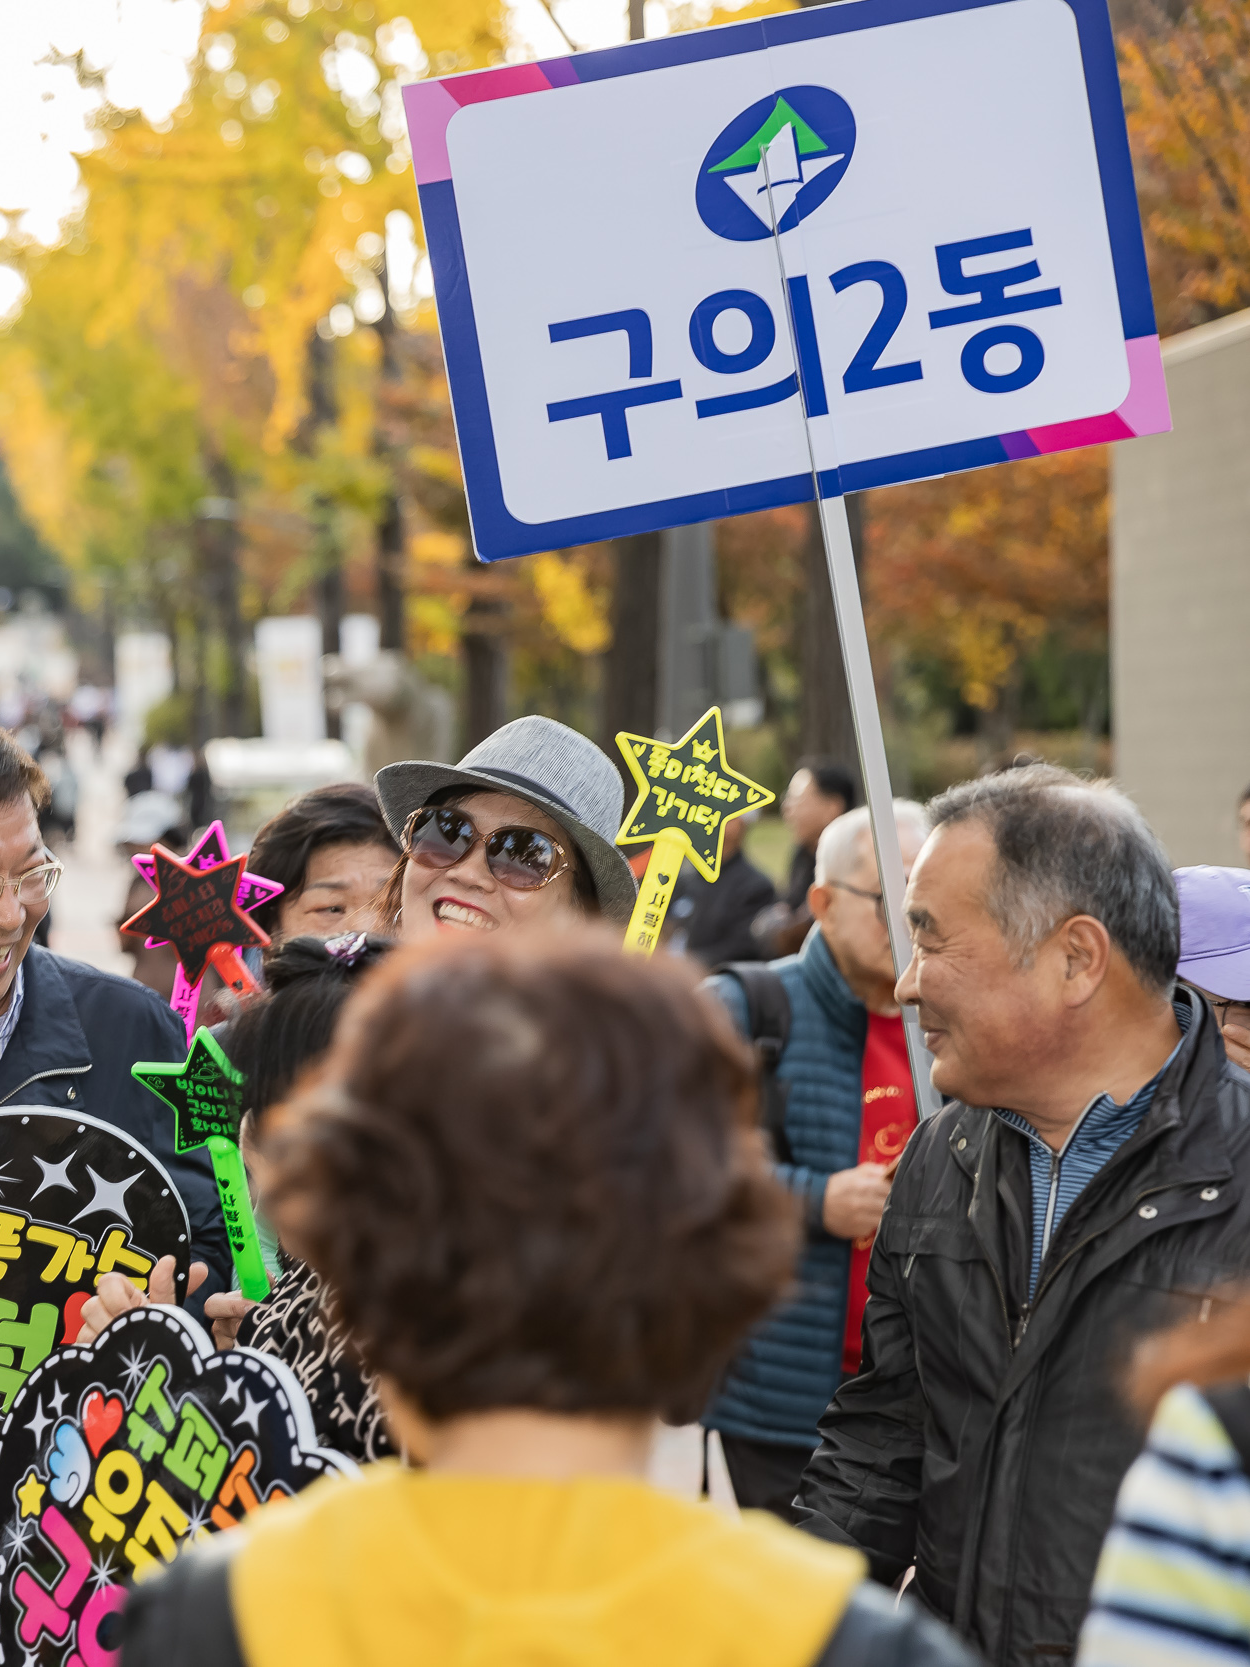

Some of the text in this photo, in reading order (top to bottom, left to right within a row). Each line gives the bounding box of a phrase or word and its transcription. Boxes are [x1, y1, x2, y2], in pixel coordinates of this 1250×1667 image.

[546, 227, 1063, 461] 구의2동
[651, 785, 721, 836] 김기덕
[186, 1098, 240, 1121] 구의2
